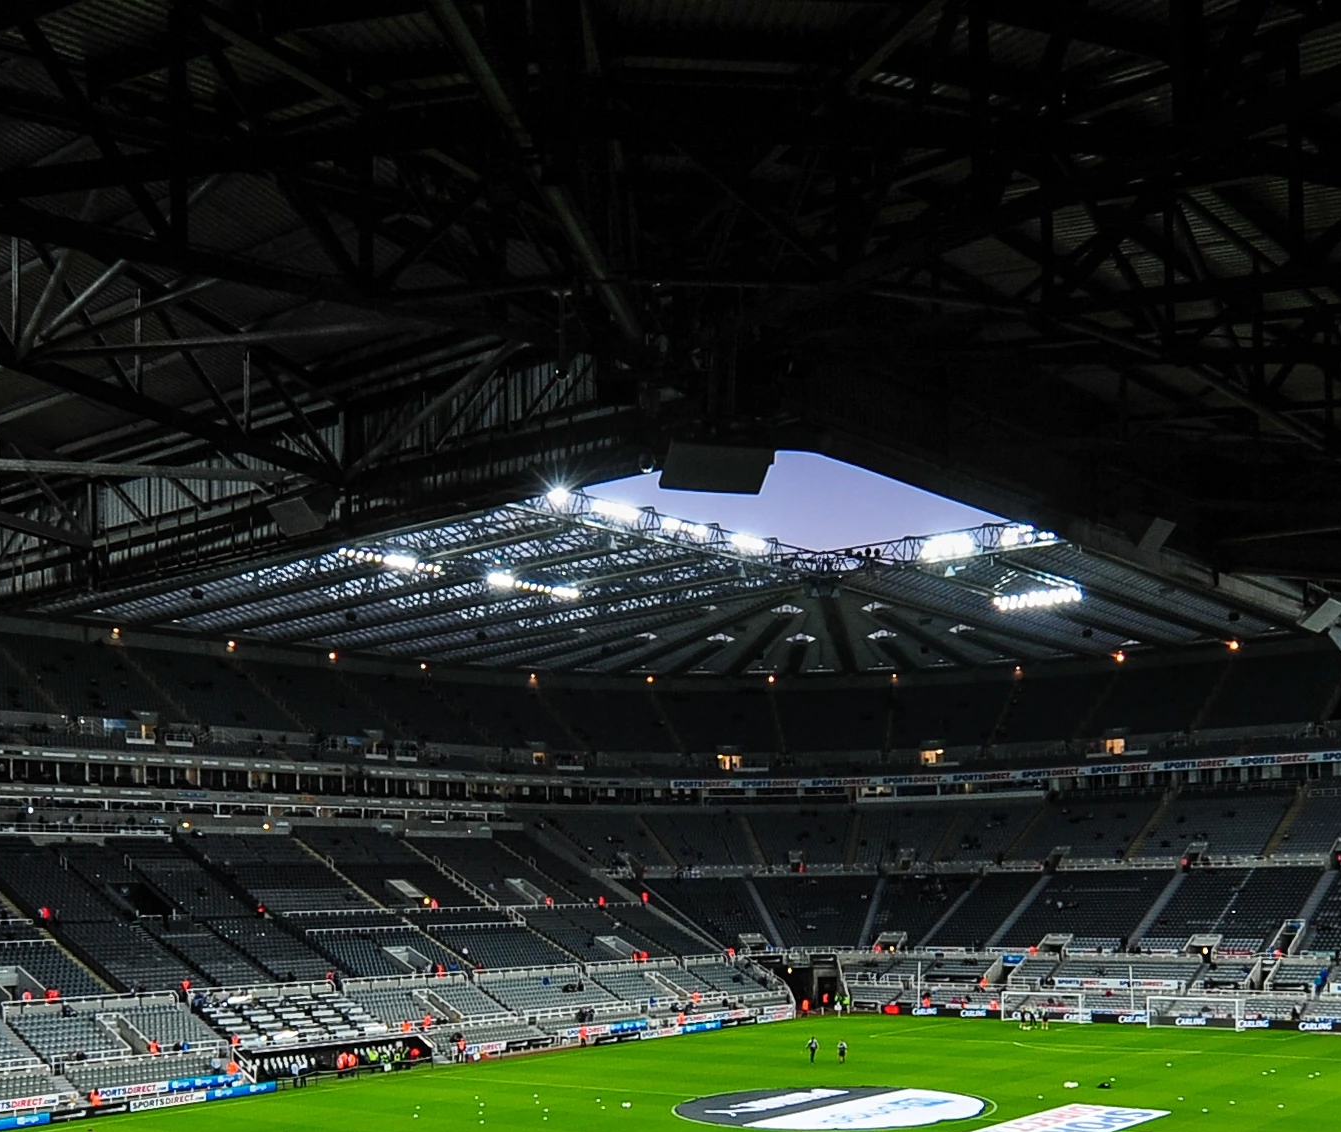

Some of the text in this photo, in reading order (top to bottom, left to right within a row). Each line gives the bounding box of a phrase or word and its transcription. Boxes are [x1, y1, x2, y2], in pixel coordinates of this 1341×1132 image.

[1175, 1017, 1206, 1026] CARLING
[1237, 1018, 1269, 1029] CARLING
[1298, 1021, 1333, 1031] CARLING
